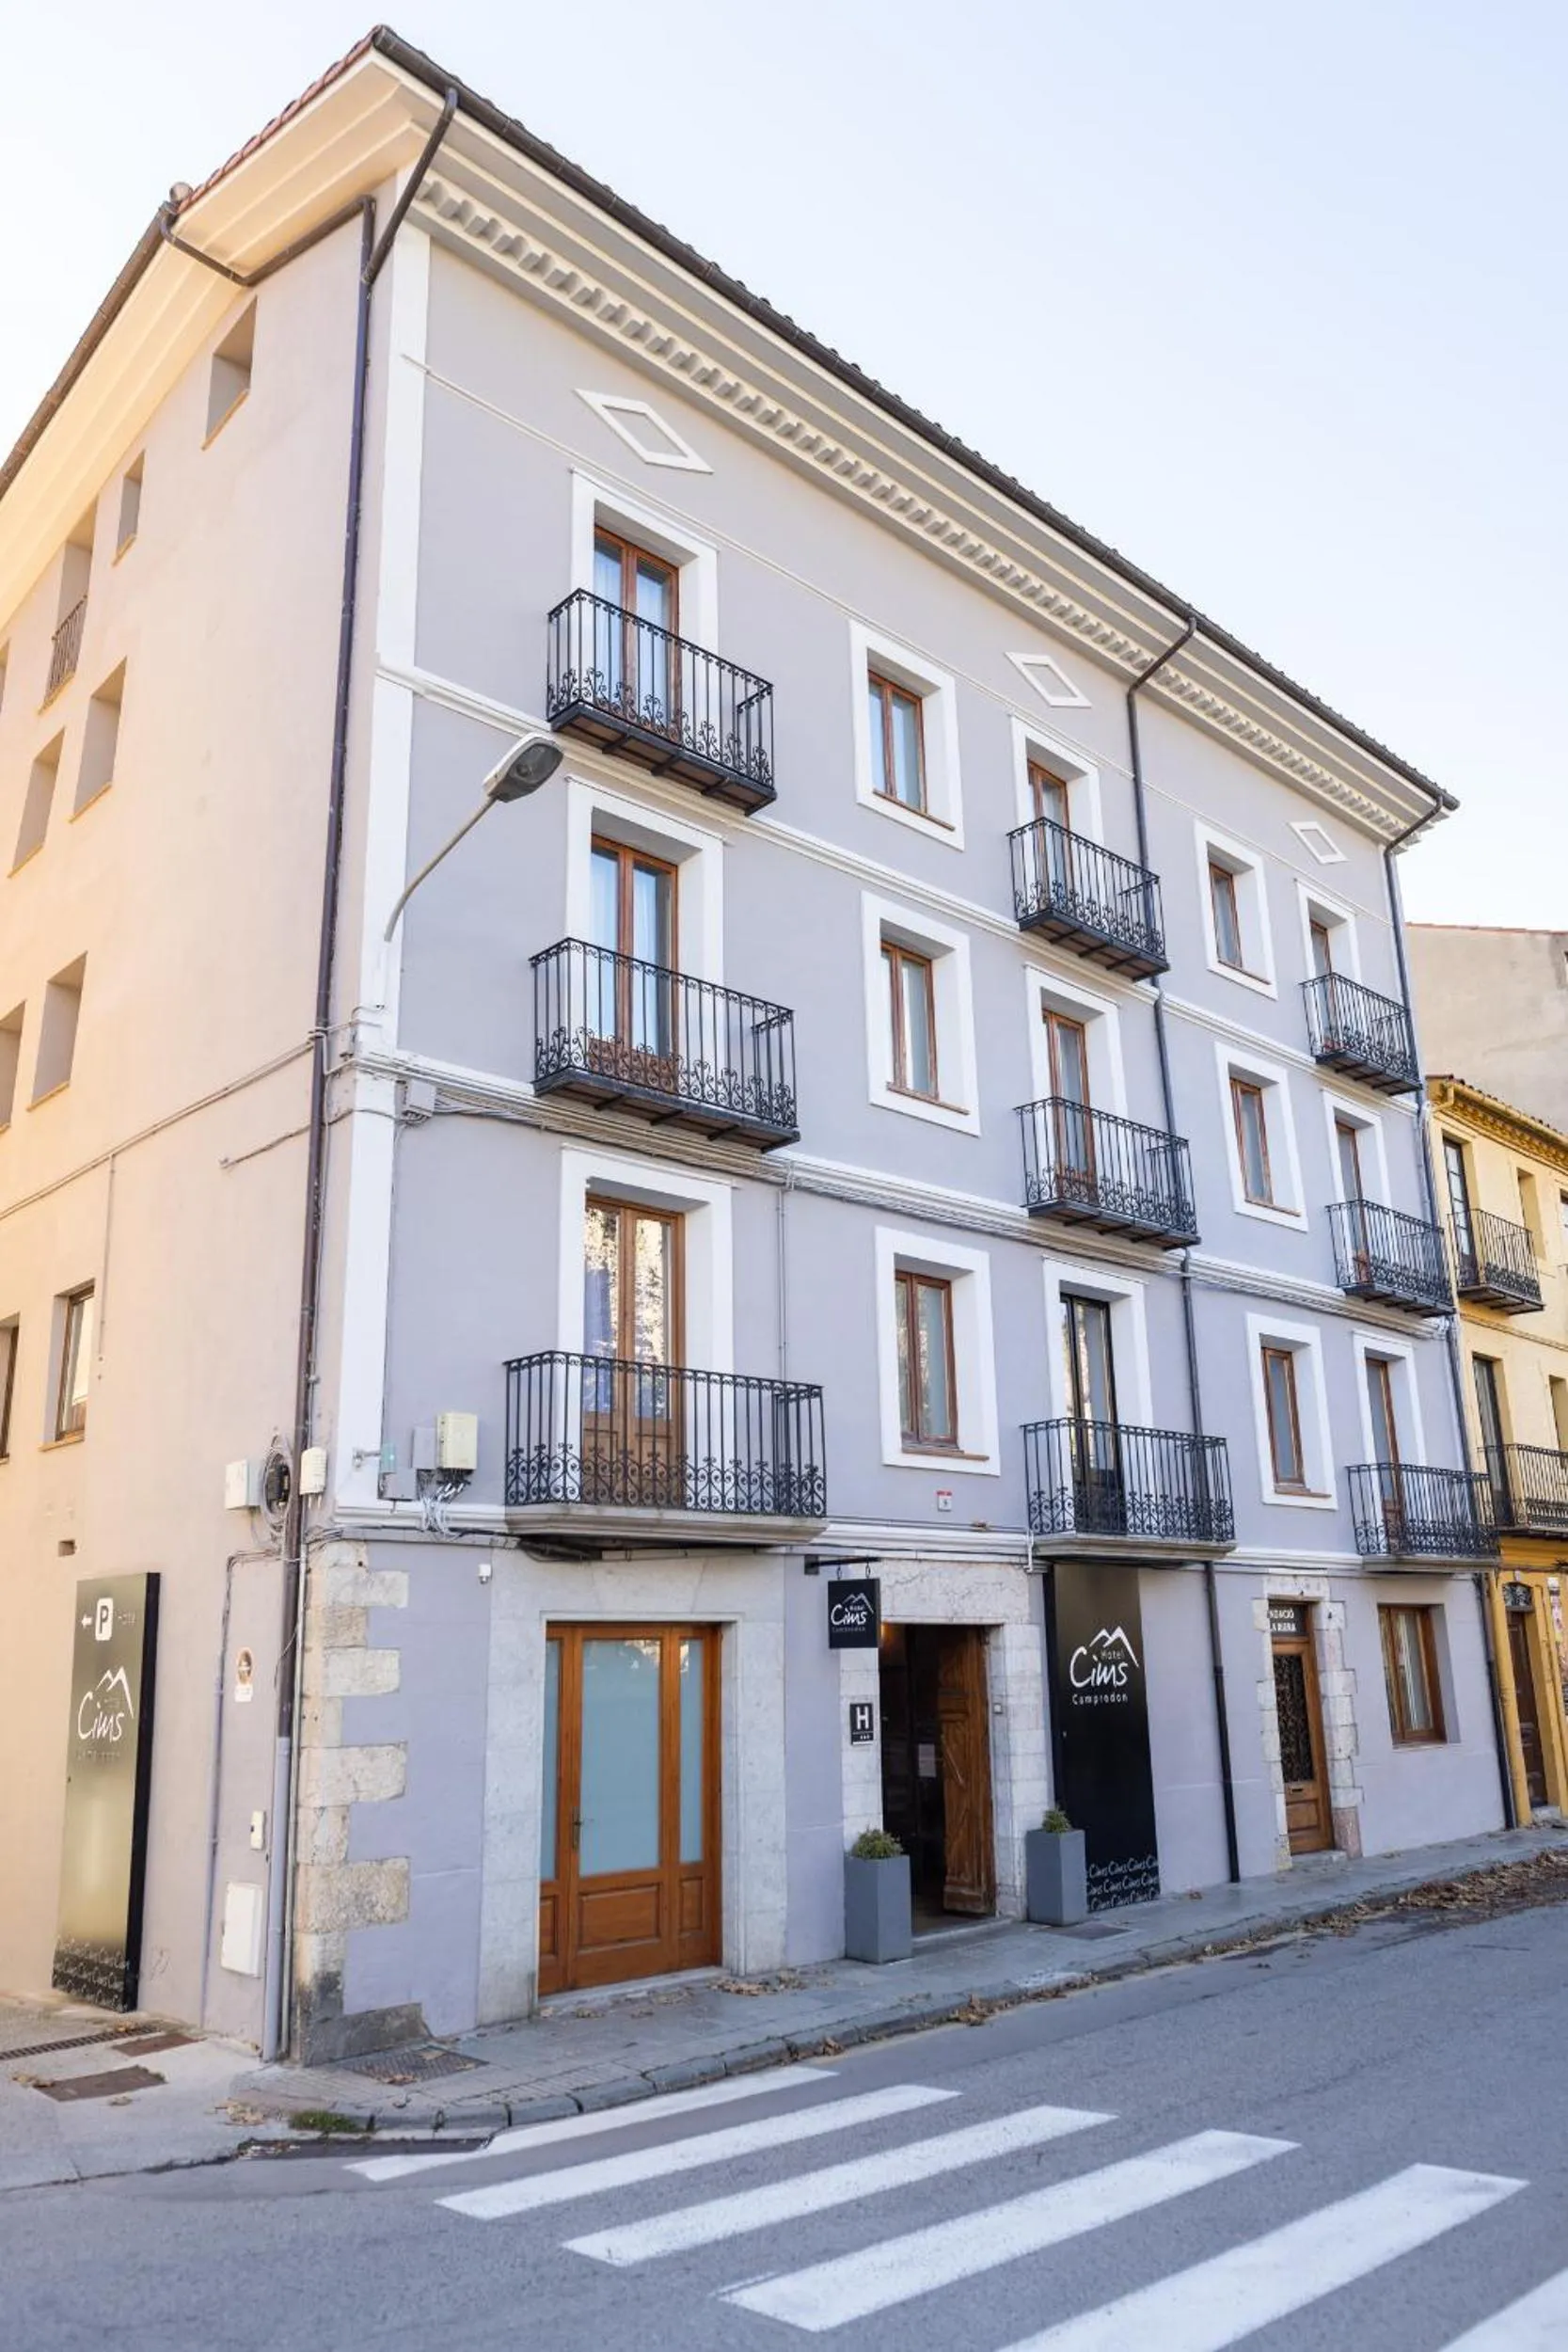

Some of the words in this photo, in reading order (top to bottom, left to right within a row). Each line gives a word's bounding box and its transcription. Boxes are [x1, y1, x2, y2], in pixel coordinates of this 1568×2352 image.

[99, 1605, 109, 1634] P
[831, 1603, 867, 1626] Cims
[1069, 1645, 1128, 1688] Cims
[1072, 1692, 1128, 1706] Camprodon
[78, 1691, 124, 1741] Cims
[856, 1706, 869, 1730] H
